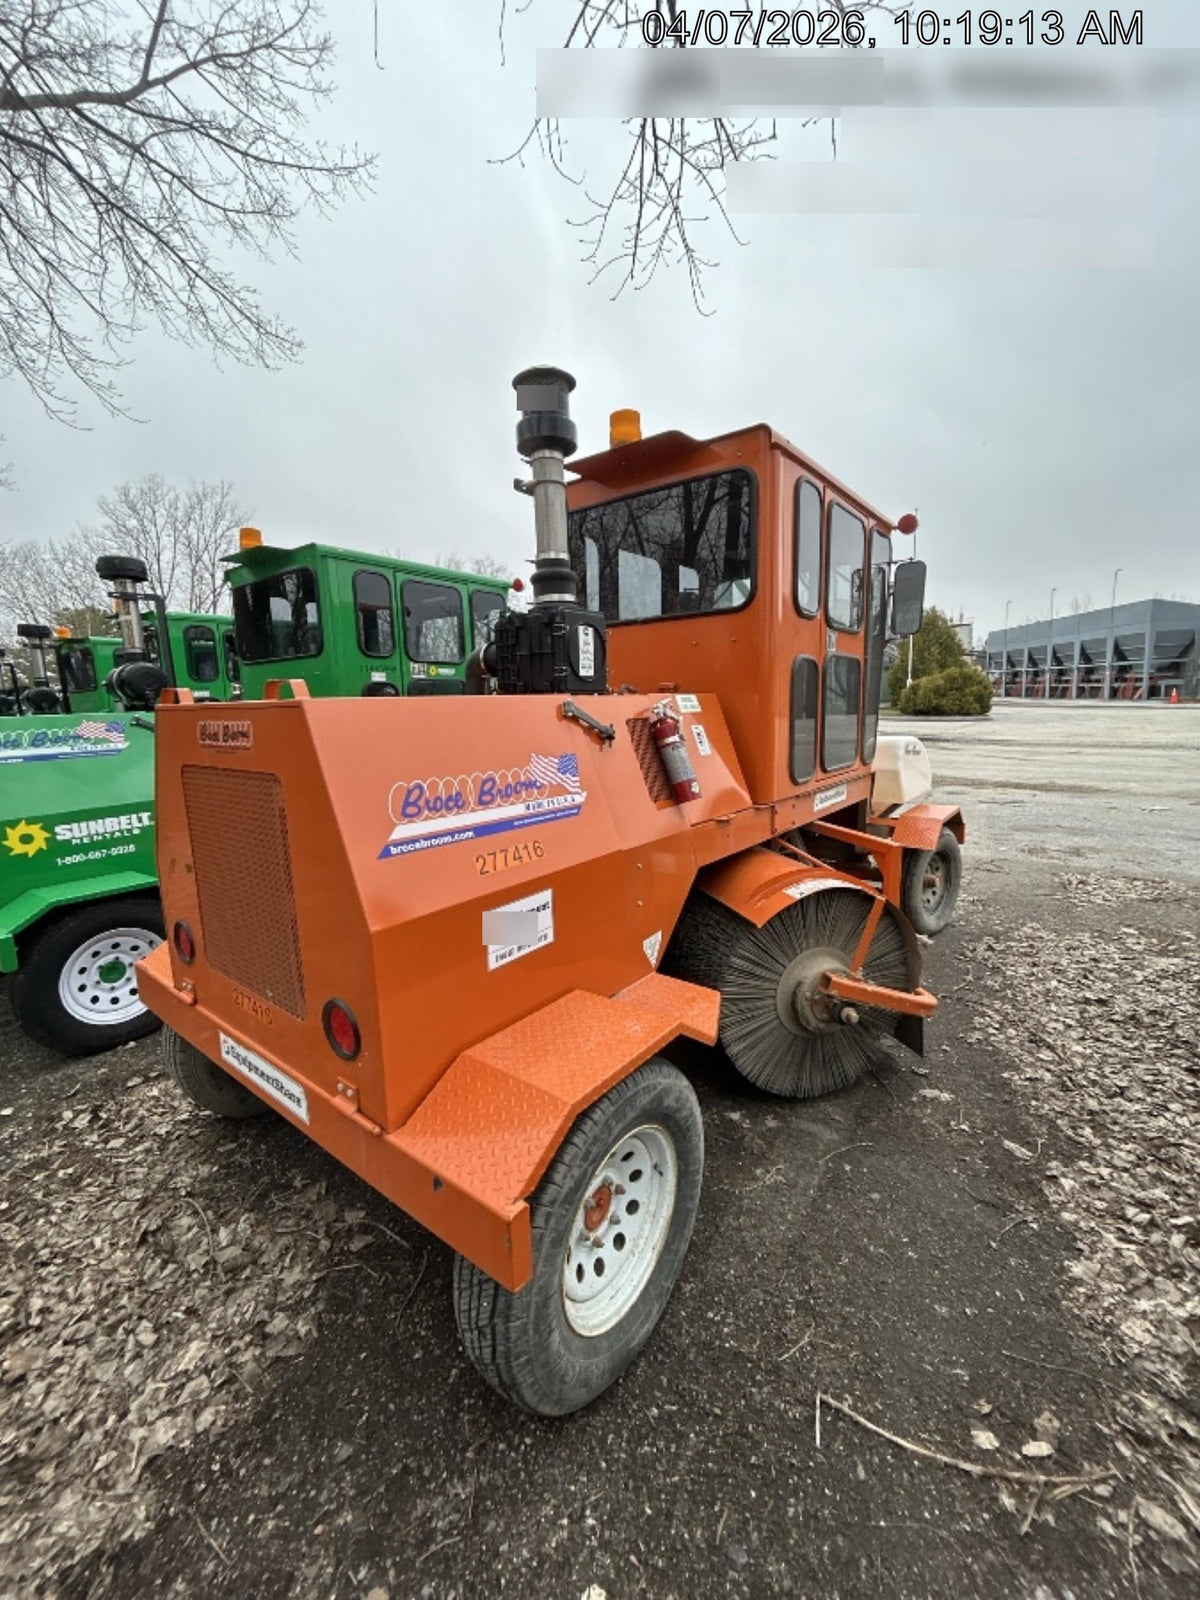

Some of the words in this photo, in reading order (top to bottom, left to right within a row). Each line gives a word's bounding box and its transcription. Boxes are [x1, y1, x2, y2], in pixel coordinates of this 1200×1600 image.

[401, 782, 466, 819] Broce
[477, 776, 543, 806] Broom
[55, 811, 152, 841] SUNBELT
[72, 827, 141, 845] RENTALS
[389, 830, 475, 855] brocebroom.com
[475, 840, 545, 875] 277416
